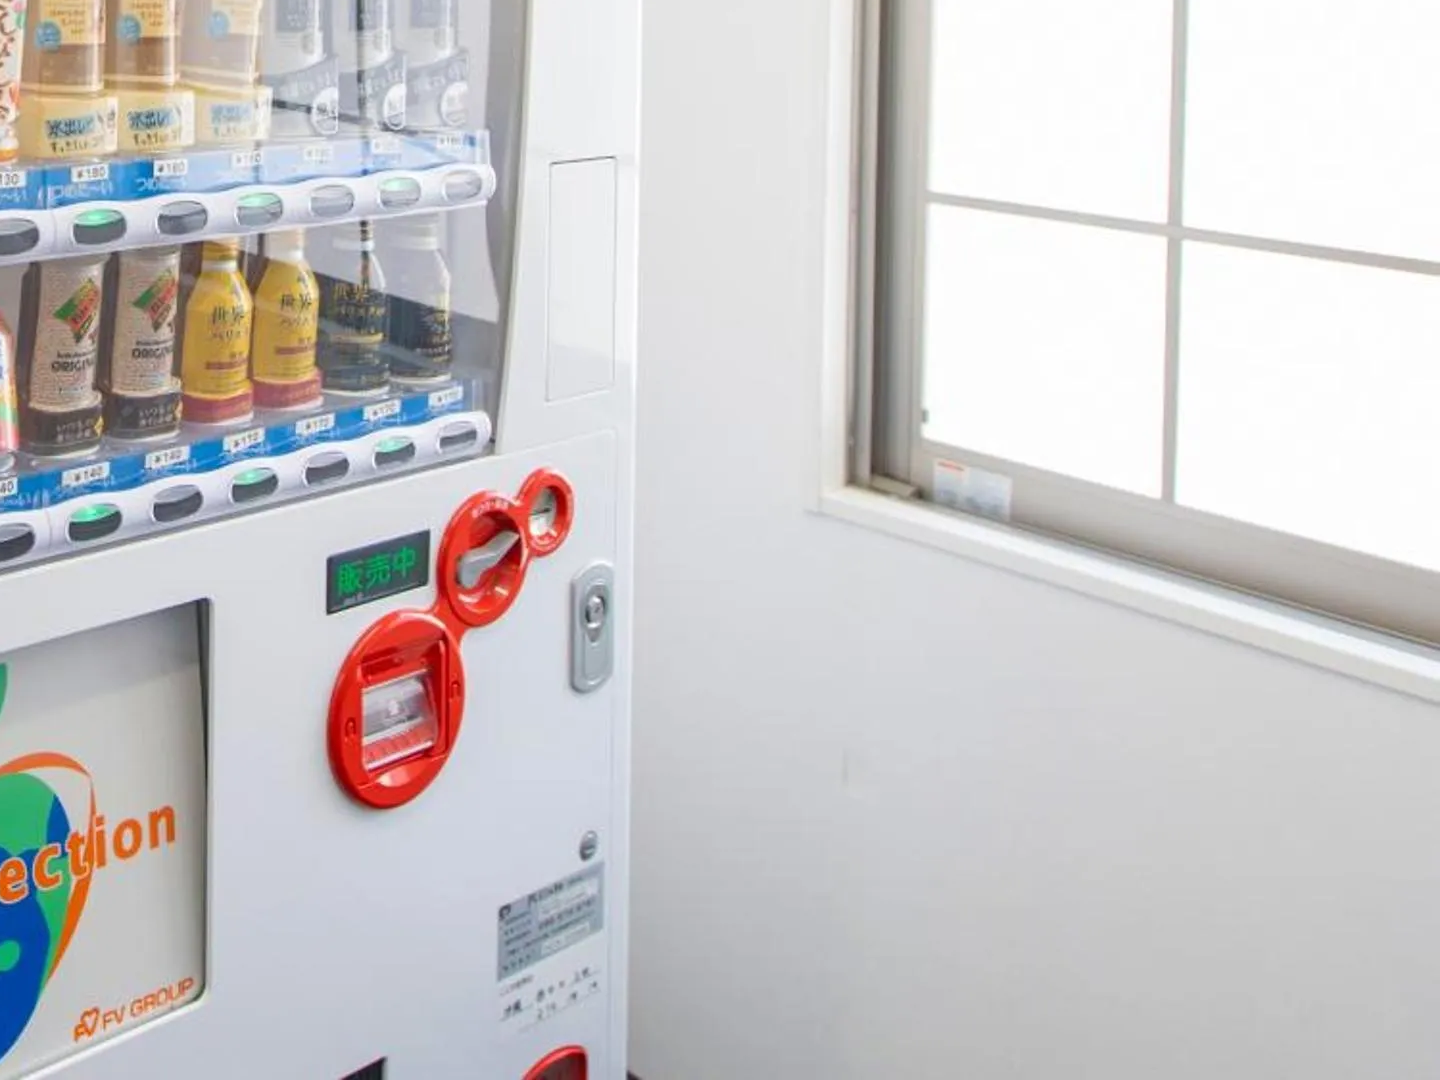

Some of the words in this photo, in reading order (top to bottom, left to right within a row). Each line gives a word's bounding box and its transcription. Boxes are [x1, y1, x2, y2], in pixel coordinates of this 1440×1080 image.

[337, 545, 416, 596] 販売中
[102, 1005, 126, 1031] FV
[129, 976, 194, 1018] GROUP
